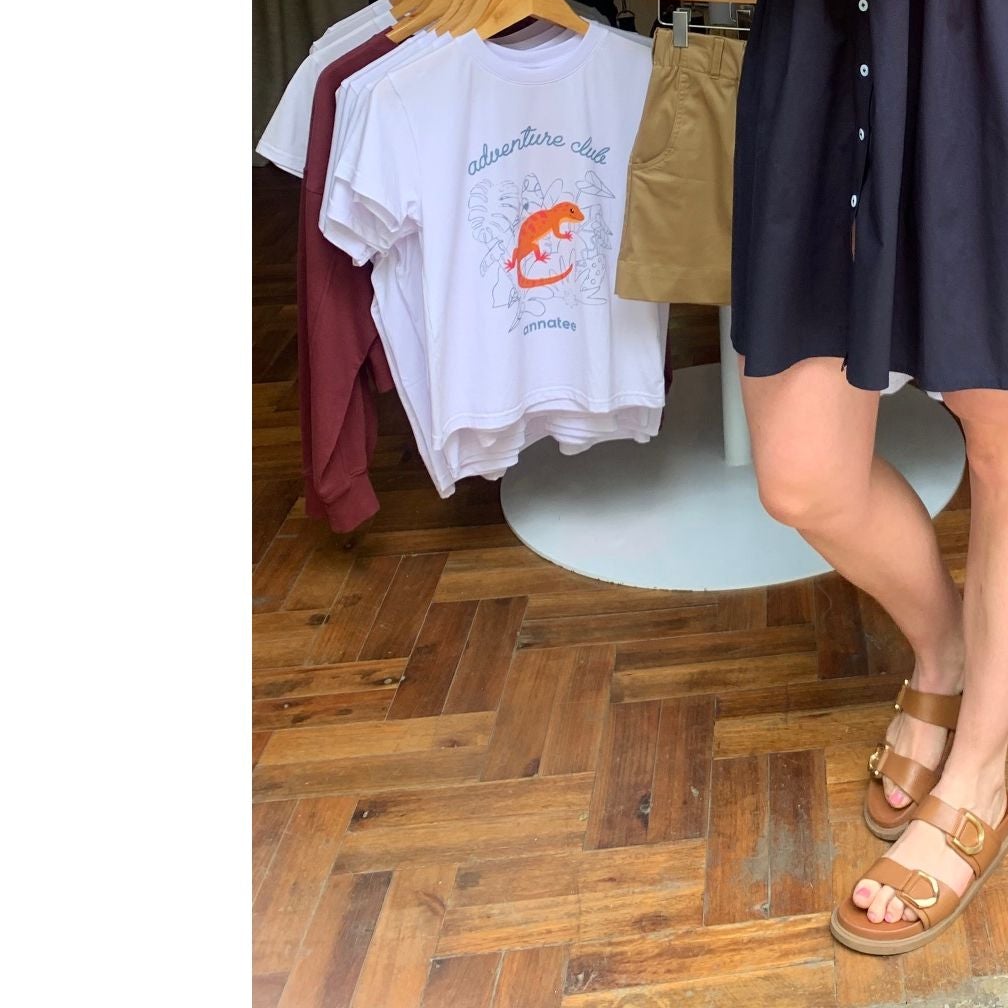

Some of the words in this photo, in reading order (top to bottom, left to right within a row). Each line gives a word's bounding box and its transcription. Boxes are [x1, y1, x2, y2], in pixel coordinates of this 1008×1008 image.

[467, 125, 566, 176] adventure
[570, 135, 611, 166] club
[523, 317, 577, 337] annatee
